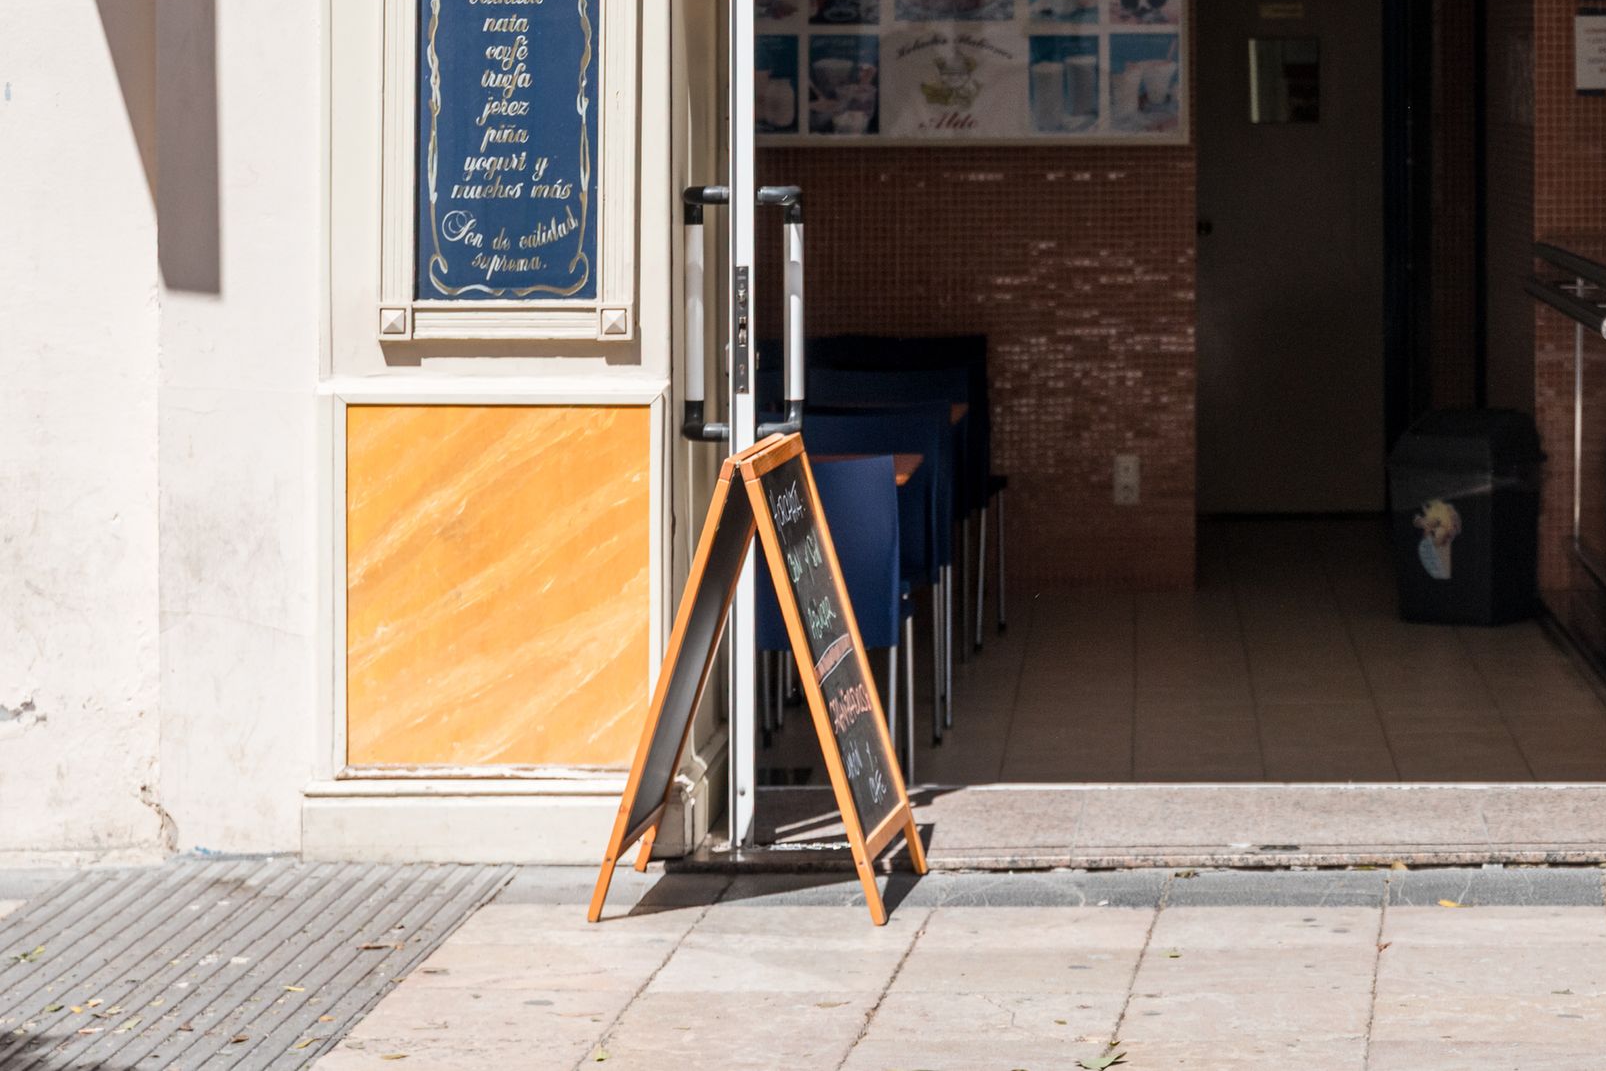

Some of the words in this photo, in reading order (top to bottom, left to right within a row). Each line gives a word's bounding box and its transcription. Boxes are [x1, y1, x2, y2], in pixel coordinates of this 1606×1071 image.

[483, 14, 529, 33] nata
[485, 35, 528, 71] café
[481, 63, 533, 98] trufa
[476, 92, 530, 126] jerez
[480, 124, 529, 153] piña
[463, 152, 527, 181] yogurt
[532, 156, 549, 181] y
[451, 176, 524, 199] muchos
[530, 179, 573, 199] más
[442, 210, 484, 248] Son
[492, 227, 511, 251] de
[519, 205, 578, 249] calidad
[472, 252, 548, 281] suprema.
